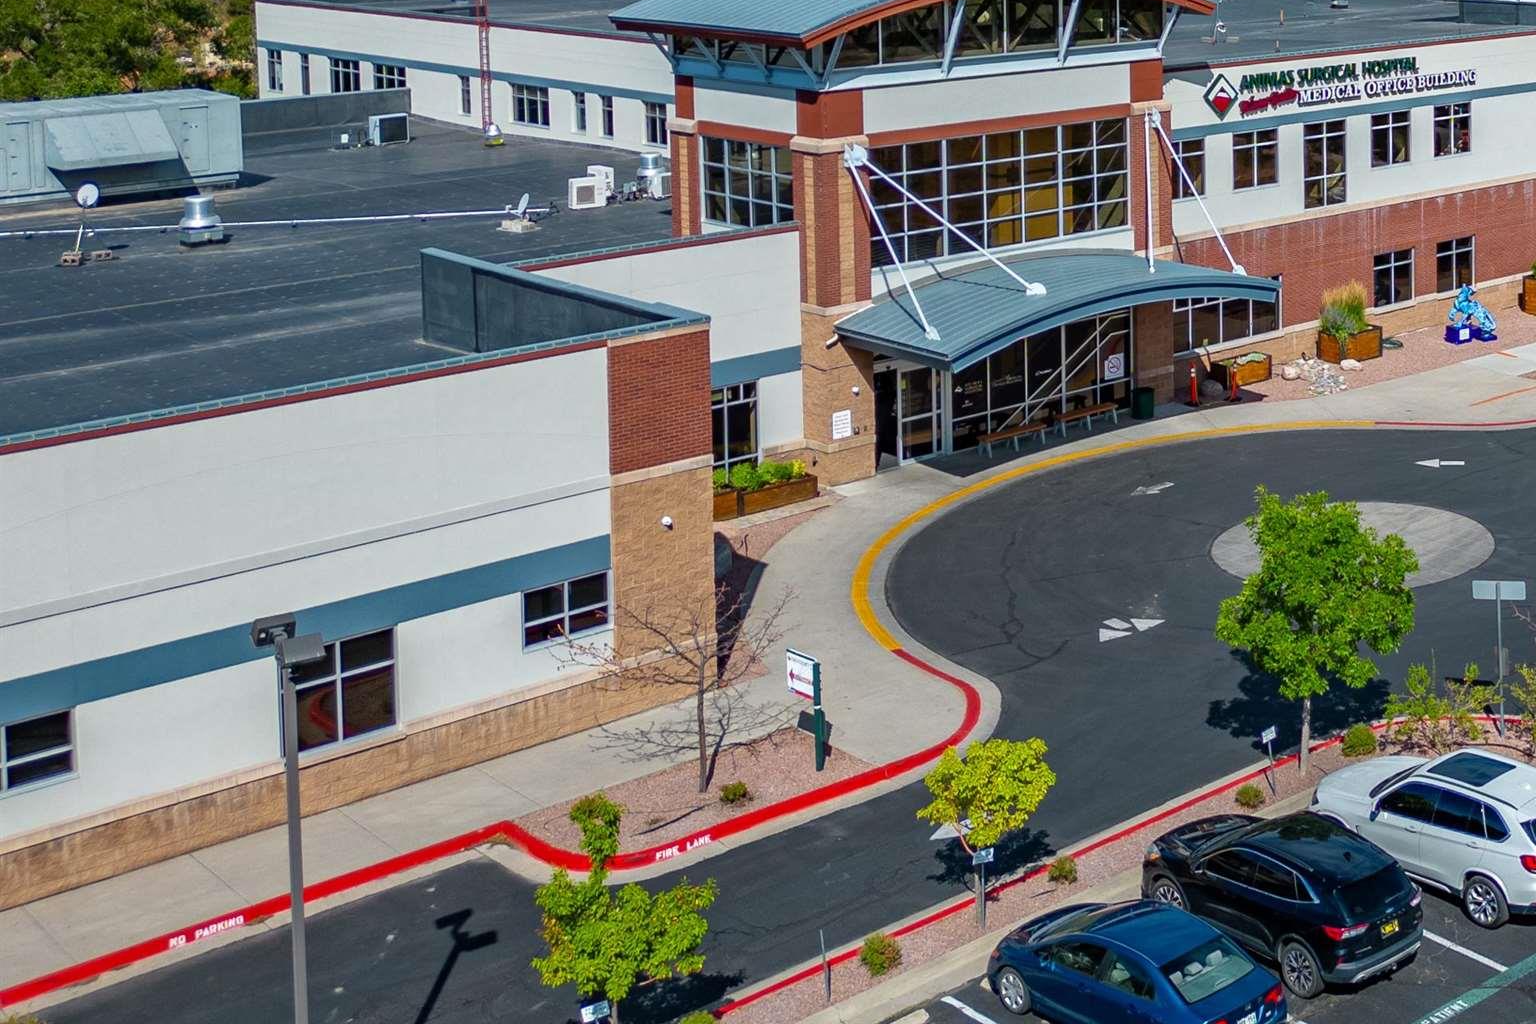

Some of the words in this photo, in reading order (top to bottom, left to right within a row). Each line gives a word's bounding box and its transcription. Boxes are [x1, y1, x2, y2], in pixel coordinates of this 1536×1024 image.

[1239, 70, 1295, 93] ANIMAS
[1297, 63, 1359, 86] SURGICAL
[1362, 57, 1419, 78] HOSPITAL
[1299, 81, 1361, 105] MEDICAL
[1365, 76, 1416, 97] OFFICE
[1417, 70, 1477, 91] BUILDING
[655, 845, 681, 861] FIRE
[686, 834, 712, 851] LANE
[168, 935, 187, 949] NO
[194, 915, 245, 941] PARKING
